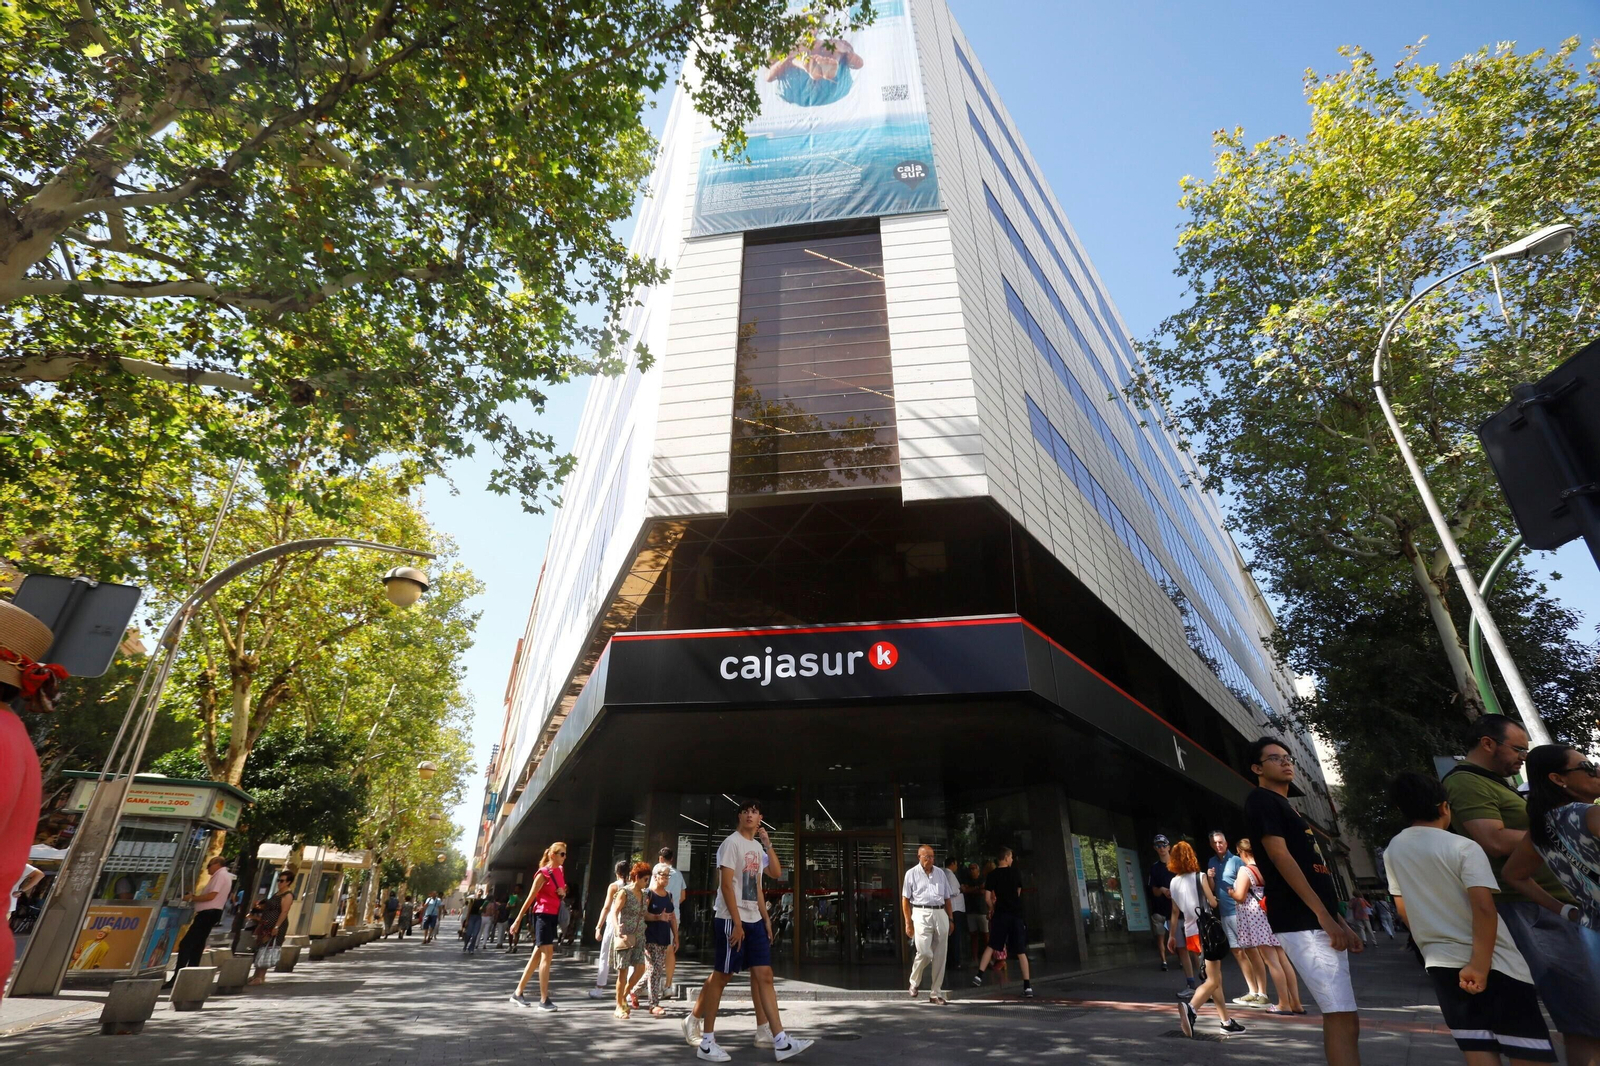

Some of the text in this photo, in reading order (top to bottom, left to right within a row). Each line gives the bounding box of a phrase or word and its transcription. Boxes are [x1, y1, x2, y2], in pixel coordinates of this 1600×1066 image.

[897, 163, 923, 173] caja
[719, 645, 864, 687] cajasur
[126, 796, 150, 804] GANA
[89, 916, 141, 931] JUGADO
